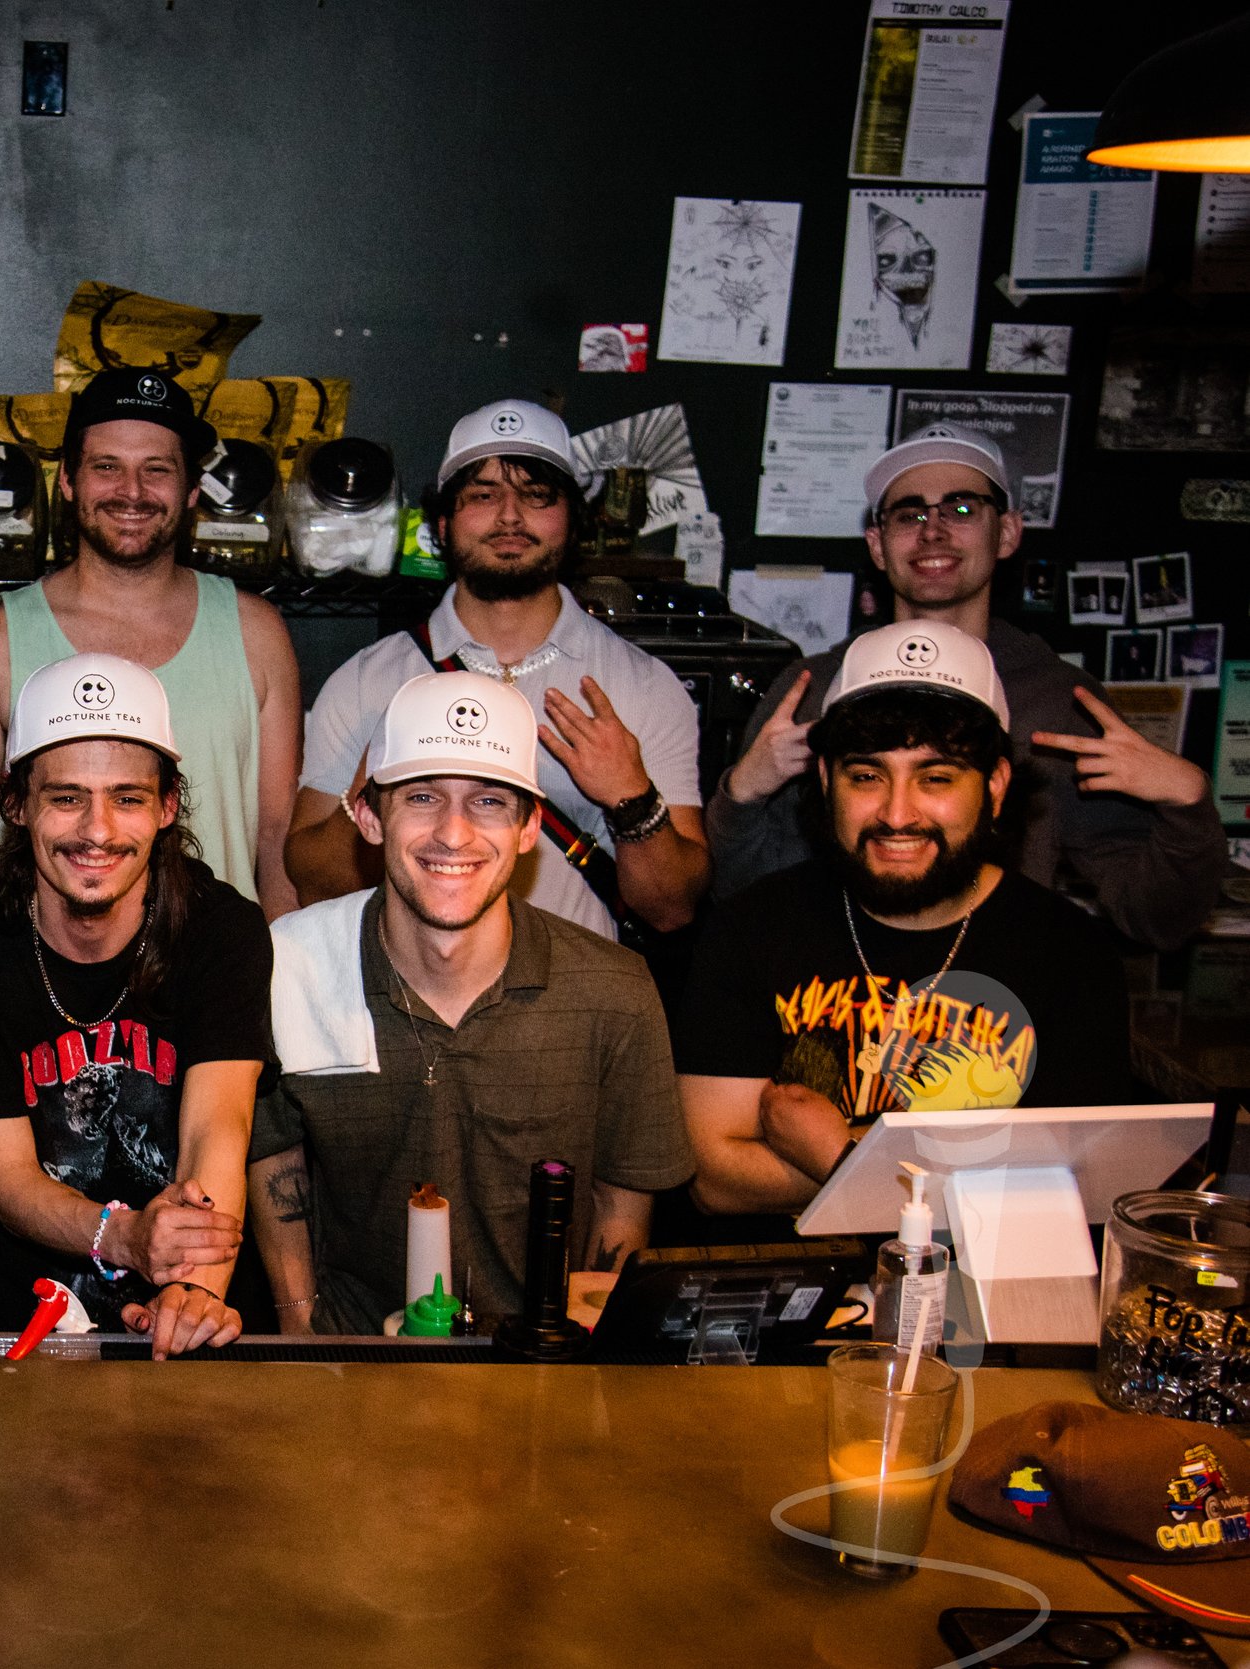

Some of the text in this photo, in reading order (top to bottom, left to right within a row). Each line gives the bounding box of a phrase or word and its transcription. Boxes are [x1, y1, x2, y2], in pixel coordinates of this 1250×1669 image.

[893, 2, 943, 16] TIMOTHY
[869, 669, 963, 685] NOCTURNE TEAS
[48, 713, 141, 726] NOCTURNE TEAS
[418, 736, 511, 755] NOCTURNE TEAS
